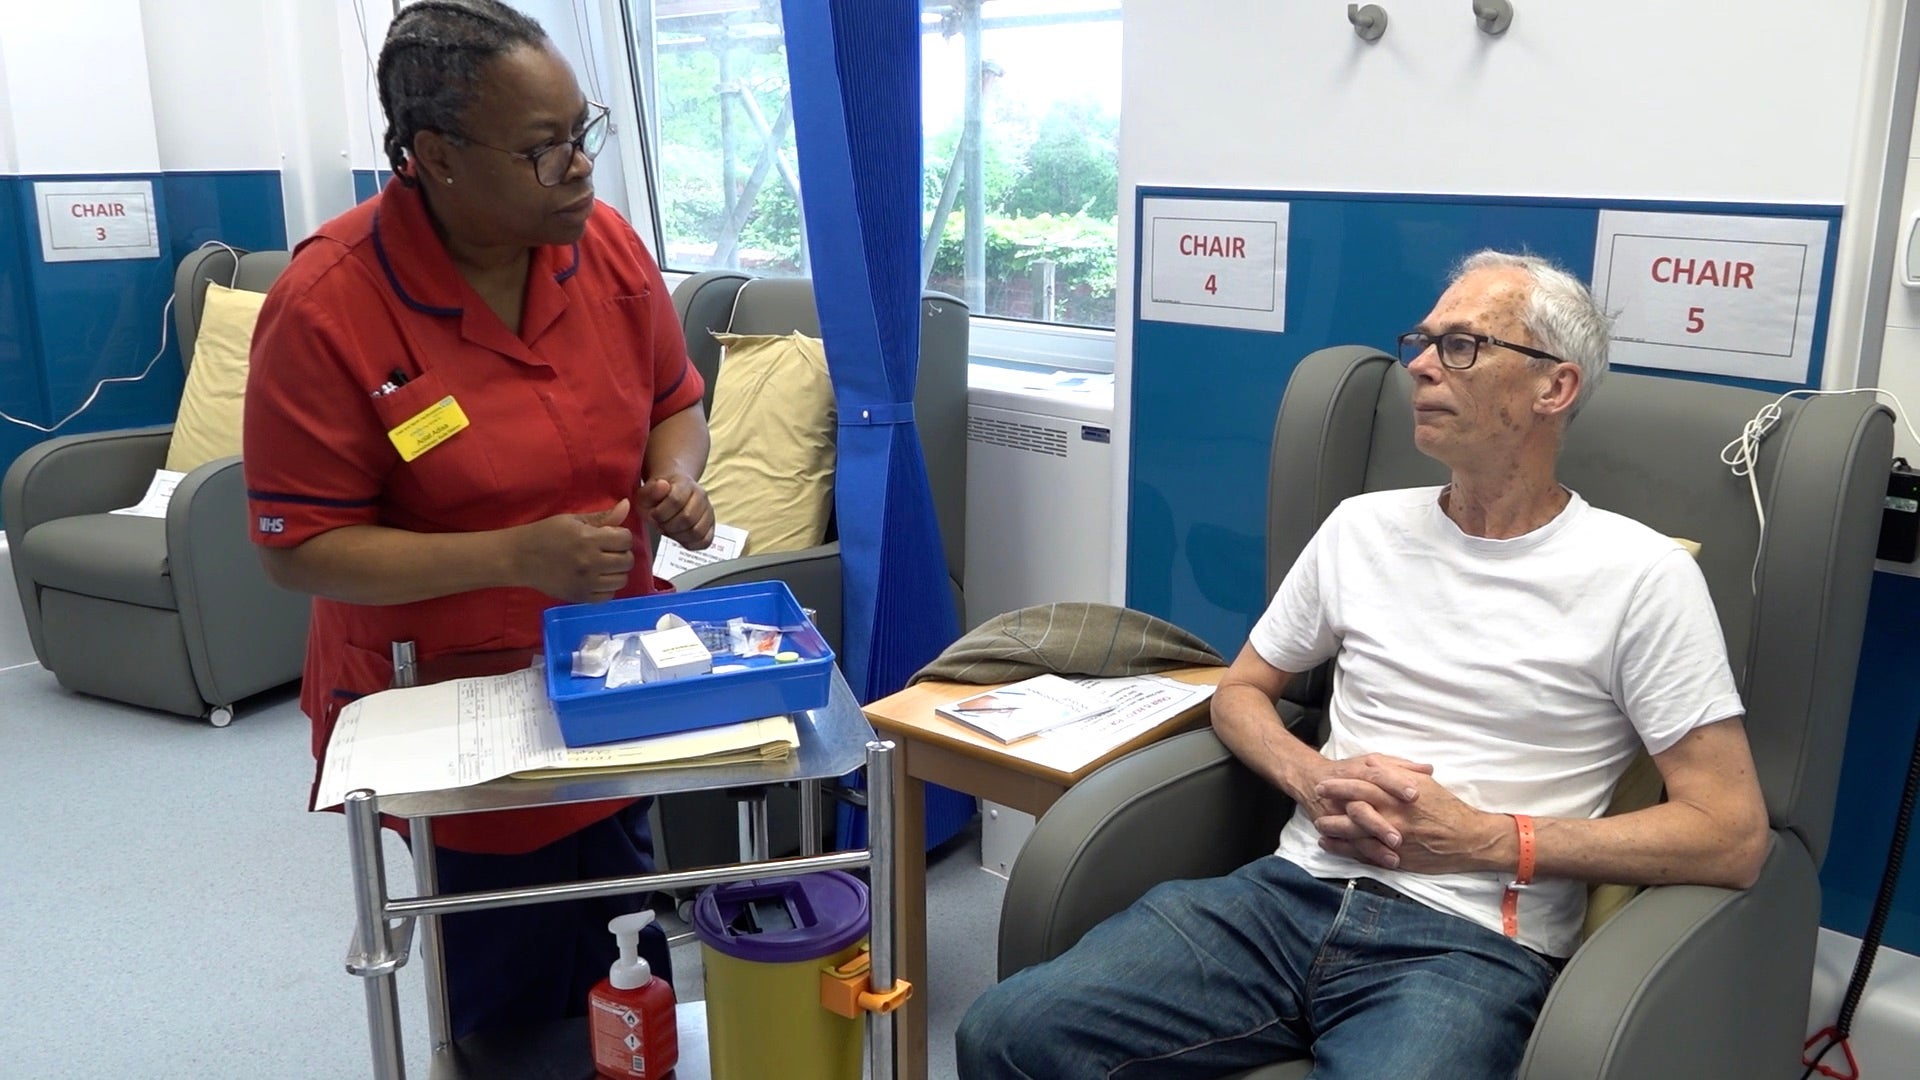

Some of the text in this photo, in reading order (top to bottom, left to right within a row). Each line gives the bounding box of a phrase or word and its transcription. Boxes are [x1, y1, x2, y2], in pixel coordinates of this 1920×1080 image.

[71, 203, 126, 217] CHAIR
[96, 227, 107, 241] 3
[1179, 234, 1246, 259] CHAIR
[1651, 256, 1755, 289] CHAIR
[1204, 274, 1217, 295] 4
[1685, 307, 1705, 333] 5
[258, 516, 285, 533] NHS
